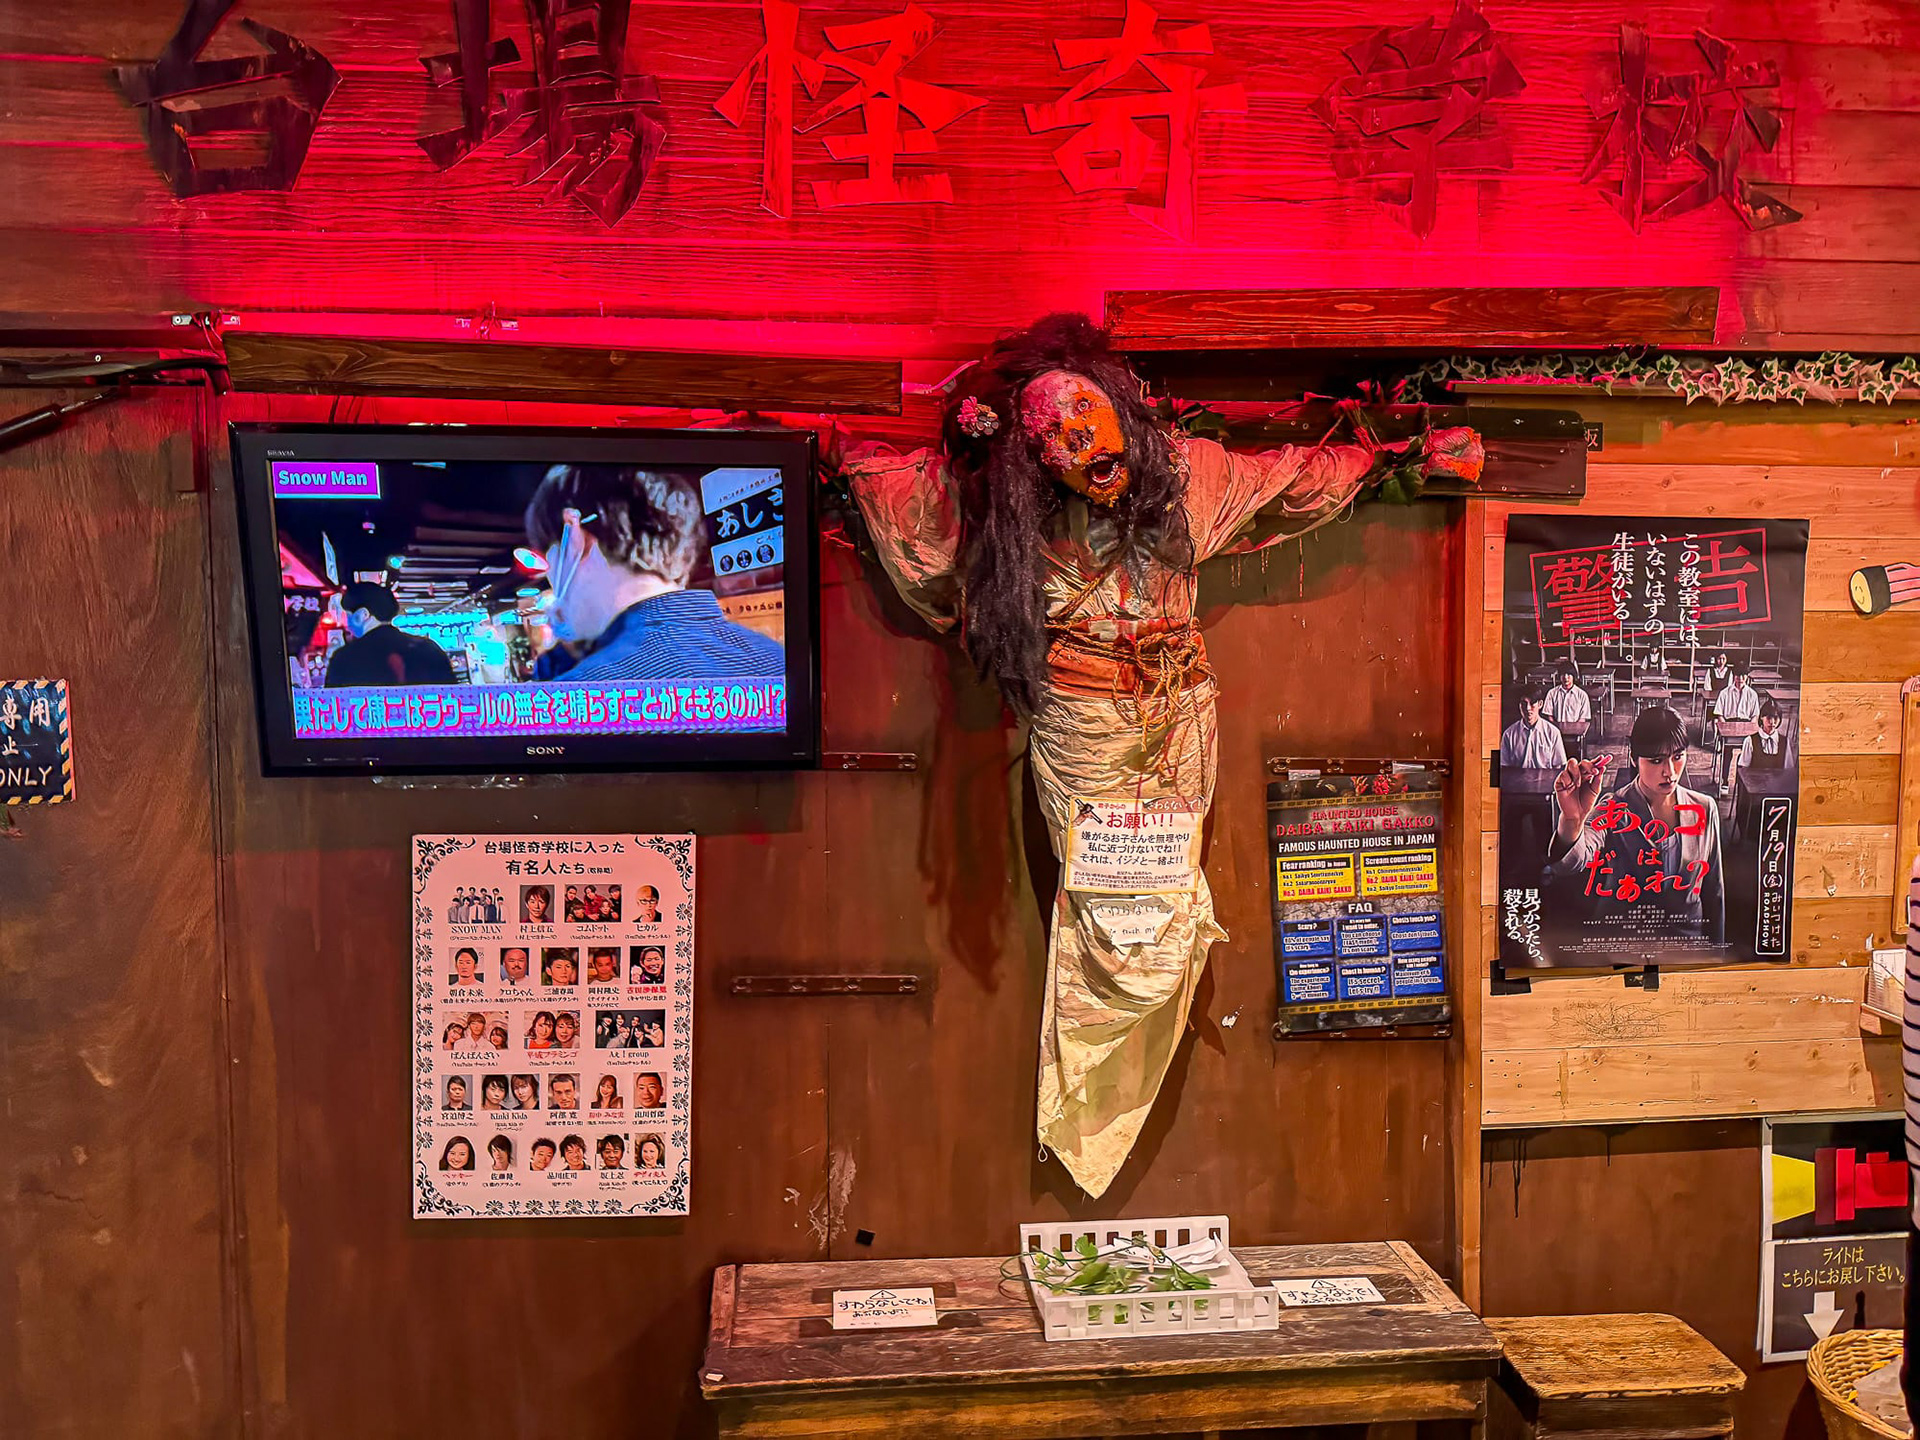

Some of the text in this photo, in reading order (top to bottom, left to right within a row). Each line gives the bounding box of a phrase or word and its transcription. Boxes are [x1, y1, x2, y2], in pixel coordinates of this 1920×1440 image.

[115, 0, 1802, 234] 台場怪奇学校
[278, 470, 368, 486] Snow Man
[1543, 541, 1759, 637] 警告
[1643, 532, 1668, 635] いないはずの
[1677, 532, 1701, 648] この教室には、
[2, 736, 19, 756] 止
[526, 746, 565, 755] SONY
[1106, 812, 1174, 829] お願い!!
[1311, 805, 1399, 821] HAUNTED HOUSE
[1590, 799, 1707, 844] あのコ
[1276, 815, 1436, 837] DAIBA KAIKI GAKKO
[1081, 831, 1190, 844] 嫌がるお子さんを無理やり
[1278, 833, 1435, 853] FAMOUS HAUNTED HOUSE IN JAPAN
[485, 841, 625, 854] 台場怪奇学校に入った
[1088, 842, 1181, 854] 私に近づけないでね!!
[1762, 805, 1788, 889] 7月19日(金)
[1080, 854, 1183, 866] それは、イジメと一緒よ!!
[1282, 861, 1298, 870] Fear
[1299, 860, 1326, 869] ranking
[1365, 854, 1433, 865] Scream count ranking
[1638, 849, 1663, 866] は
[1348, 902, 1373, 914] FAQ
[1503, 888, 1525, 944] 殺される。
[576, 924, 609, 932] コムドット
[636, 923, 659, 932] ヒカル
[1522, 888, 1544, 962] 見つかったら、
[1761, 892, 1770, 947] ROADSHOW
[451, 925, 501, 934] SNOW MAN
[628, 1051, 649, 1059] group
[1822, 1245, 1865, 1265] ライトは
[1781, 1263, 1906, 1288] こちらにお戻し下さい。
